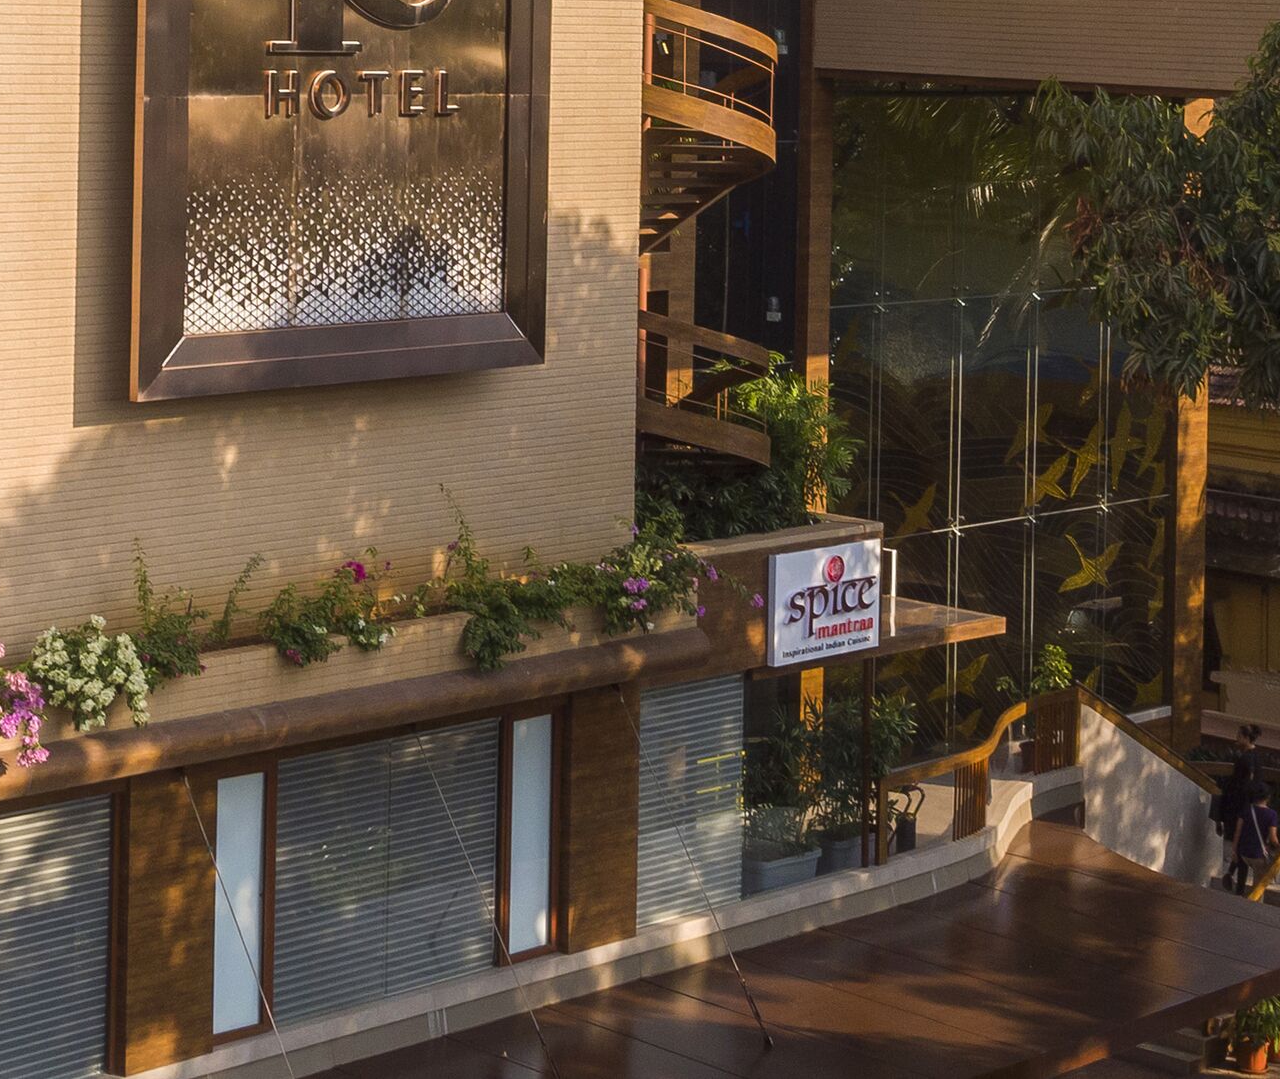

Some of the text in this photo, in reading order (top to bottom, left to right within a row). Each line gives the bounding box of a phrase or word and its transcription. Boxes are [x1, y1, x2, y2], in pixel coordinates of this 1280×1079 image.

[264, 69, 460, 120] HOTEL
[786, 558, 877, 639] spice
[782, 643, 824, 659] Inspirational
[825, 639, 846, 651] Indian
